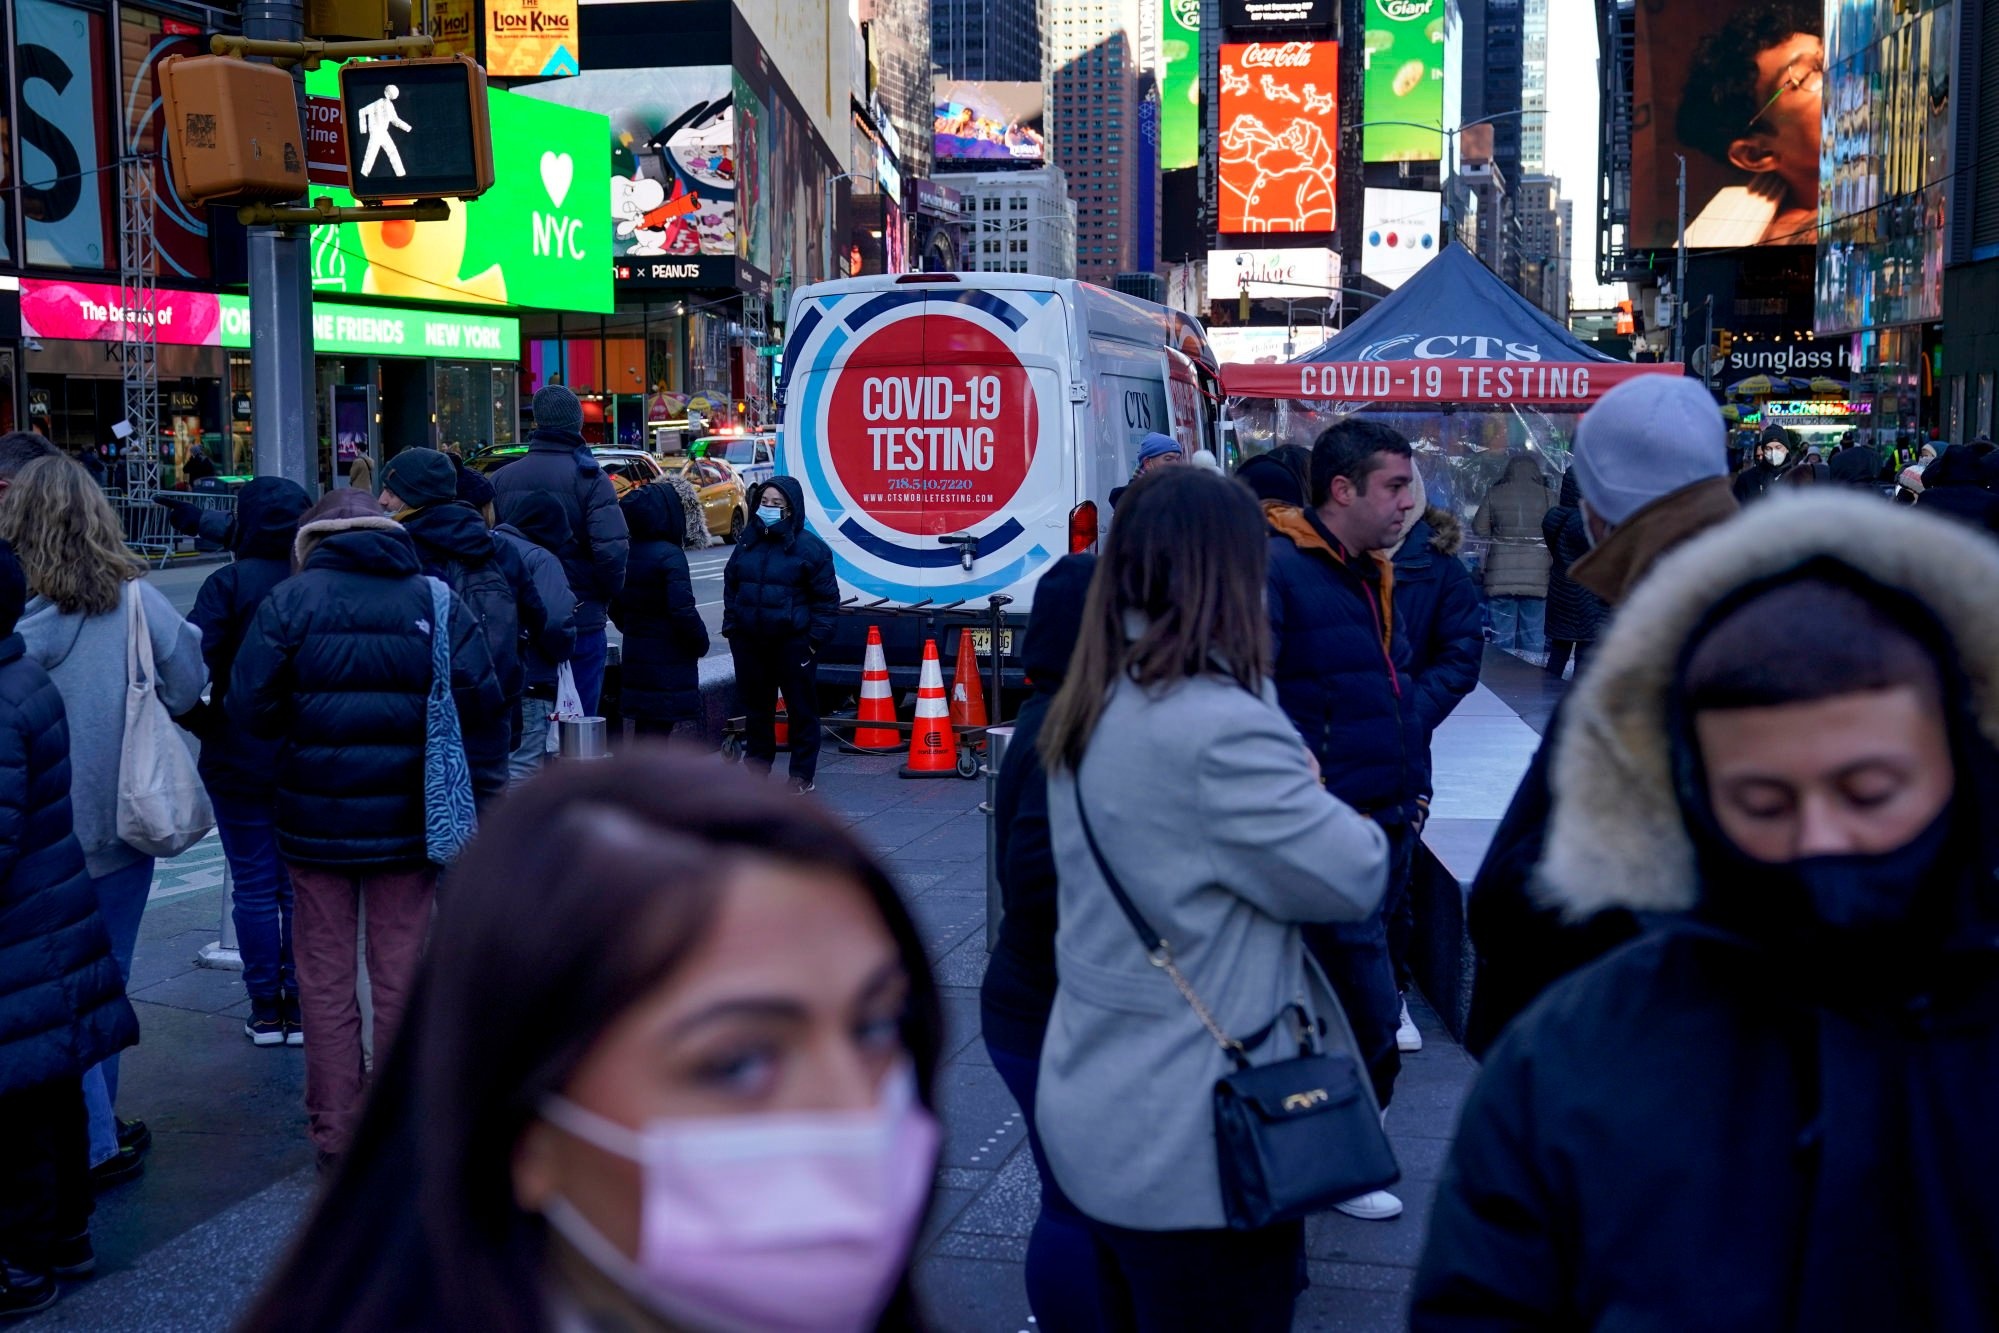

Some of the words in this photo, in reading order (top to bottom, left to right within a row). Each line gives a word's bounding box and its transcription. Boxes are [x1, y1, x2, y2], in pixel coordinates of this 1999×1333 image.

[531, 11, 569, 32] KING
[532, 210, 585, 260] NYC
[652, 264, 700, 279] PEANUTS
[80, 301, 107, 322] The
[158, 306, 172, 325] of
[336, 315, 404, 345] FRIENDS
[425, 322, 461, 348] NEW
[463, 324, 502, 350] YORK
[1414, 335, 1541, 362] CTS
[1731, 344, 1832, 374] sunglass
[863, 375, 1000, 421] COVID-19
[1301, 365, 1442, 397] COVID-19
[1458, 366, 1590, 399] TESTING
[1124, 390, 1151, 430] CTS
[867, 427, 994, 471] TESTING
[863, 493, 993, 503] WWW.CTSMOBLETESTING.COM
